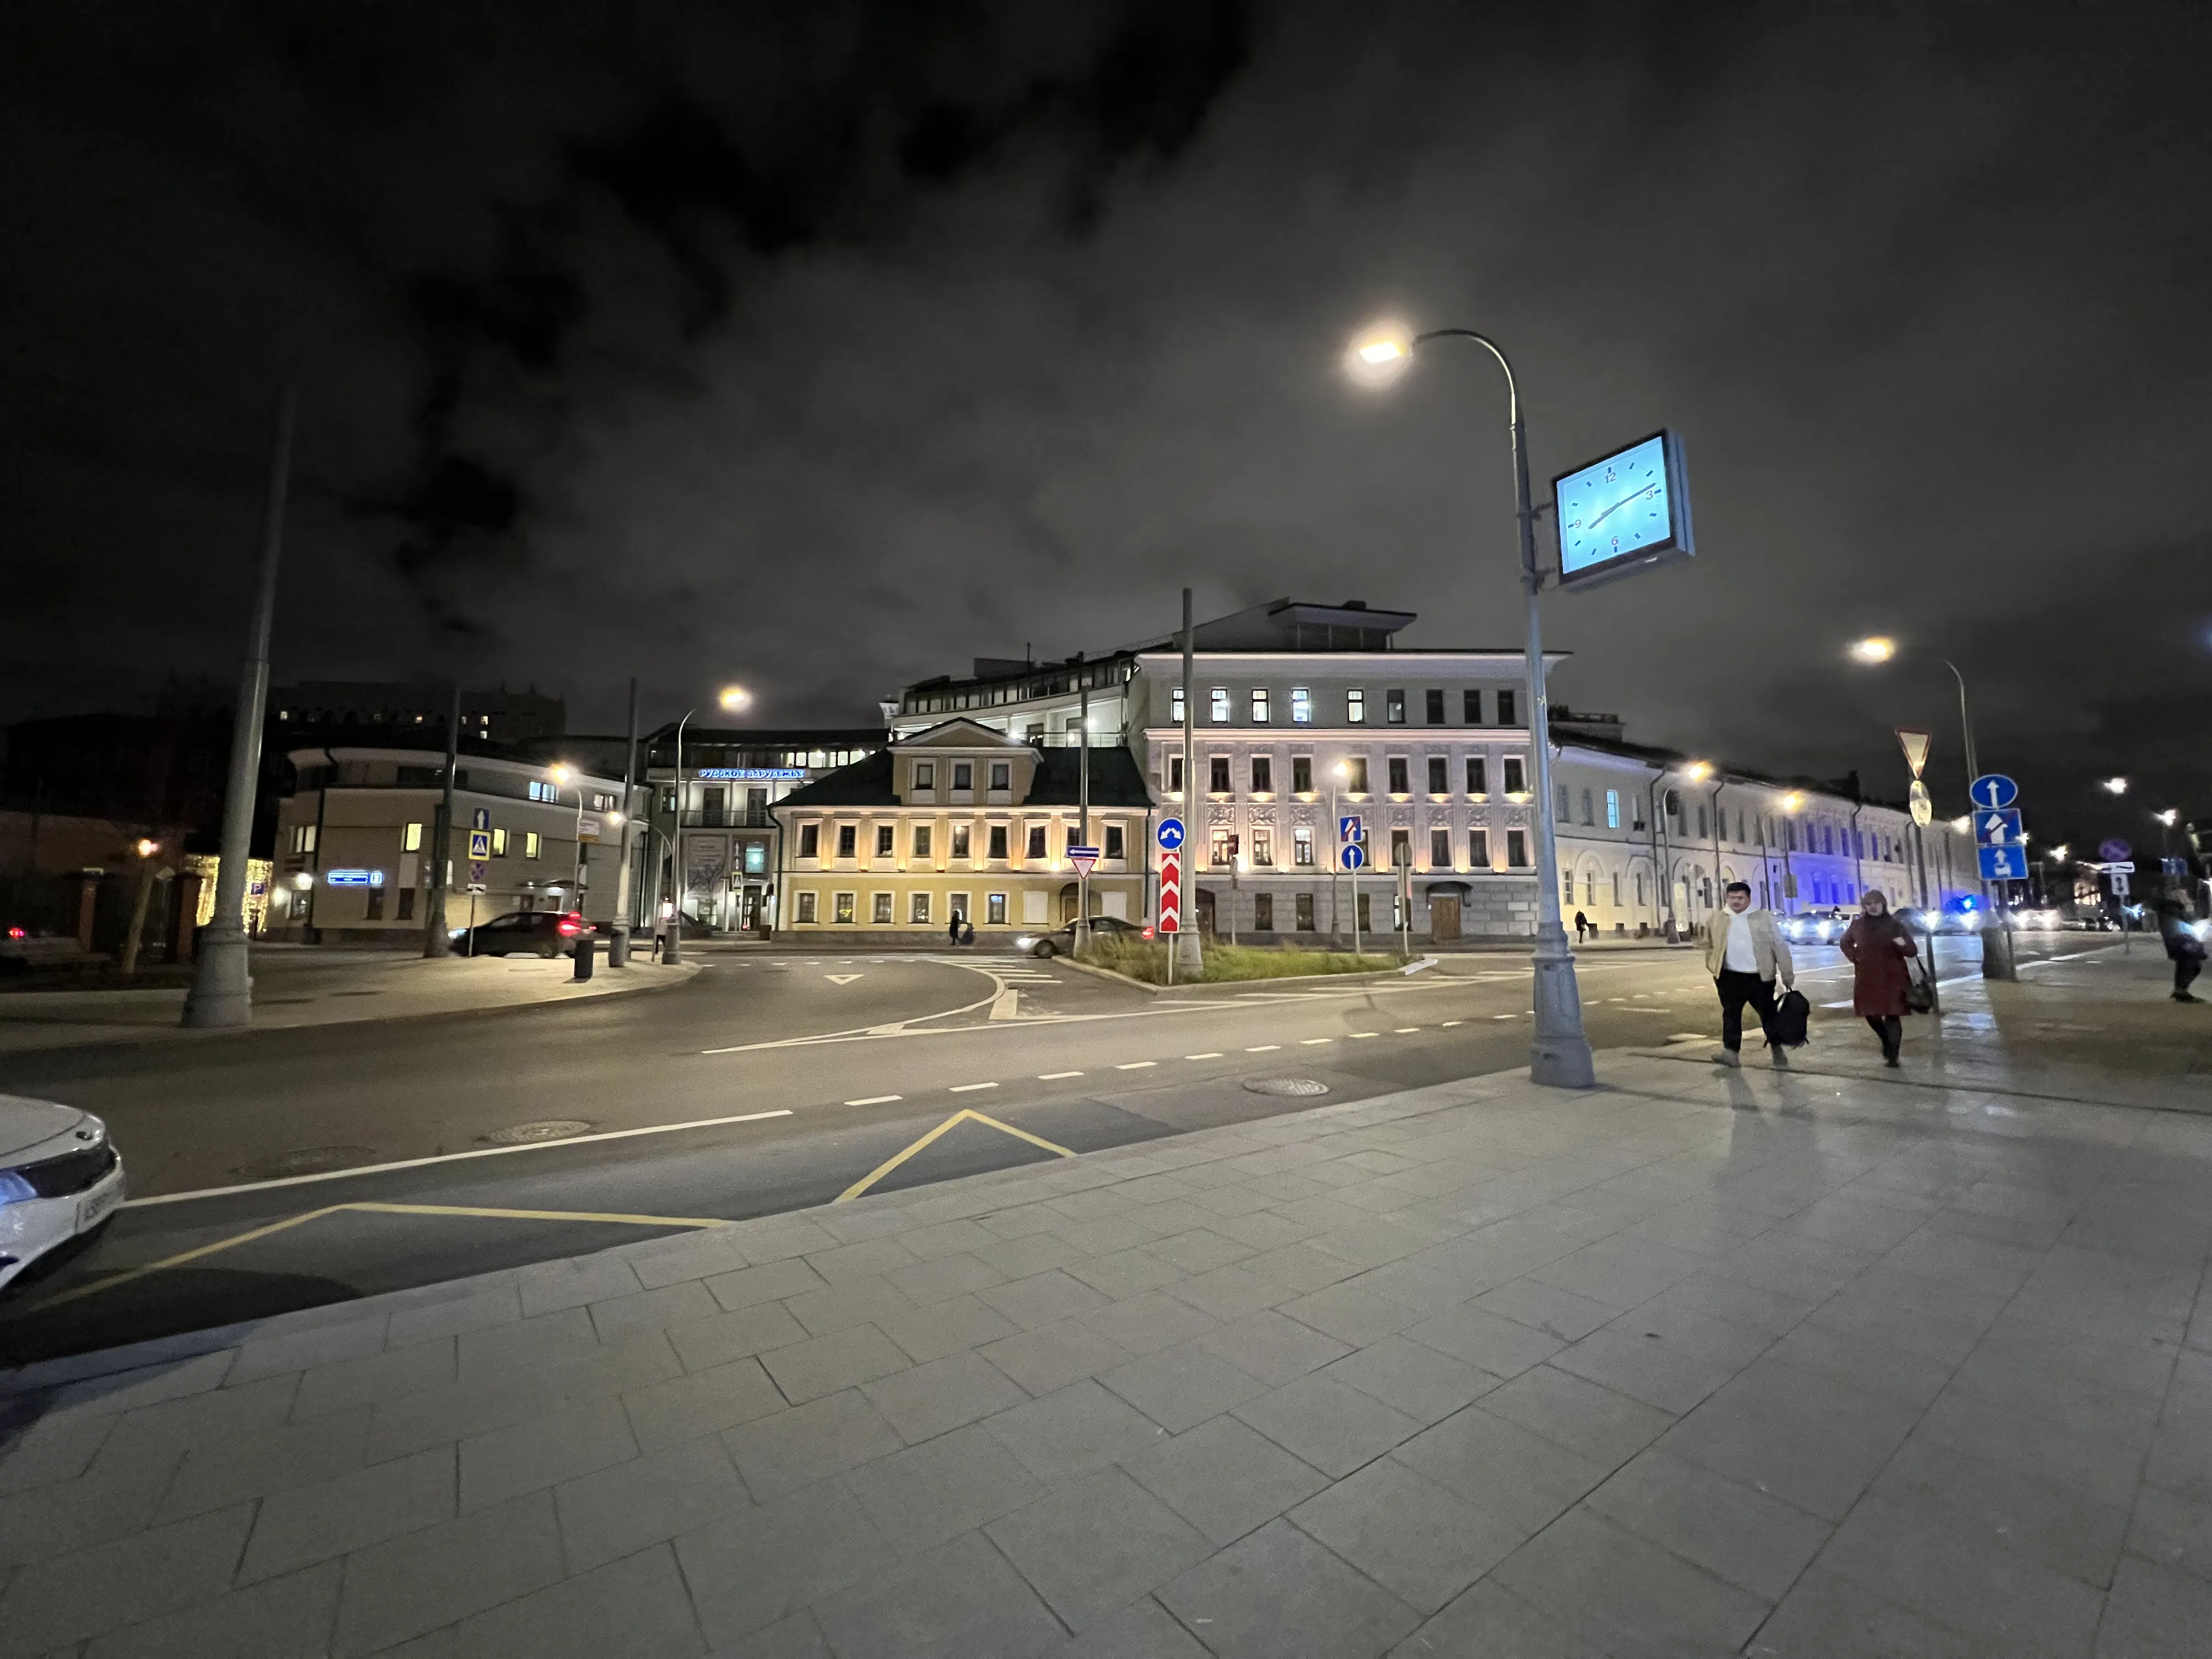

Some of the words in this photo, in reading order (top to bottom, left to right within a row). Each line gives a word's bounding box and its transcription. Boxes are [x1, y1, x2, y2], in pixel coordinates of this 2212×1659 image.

[1604, 472, 1617, 484] 12
[1646, 490, 1654, 500] 3
[1575, 519, 1582, 528] 9
[1611, 536, 1618, 545] 6
[699, 769, 746, 778] РУССКОЕ
[747, 769, 804, 778] ЗАРУБЕЖЬЕ
[253, 883, 262, 894] P
